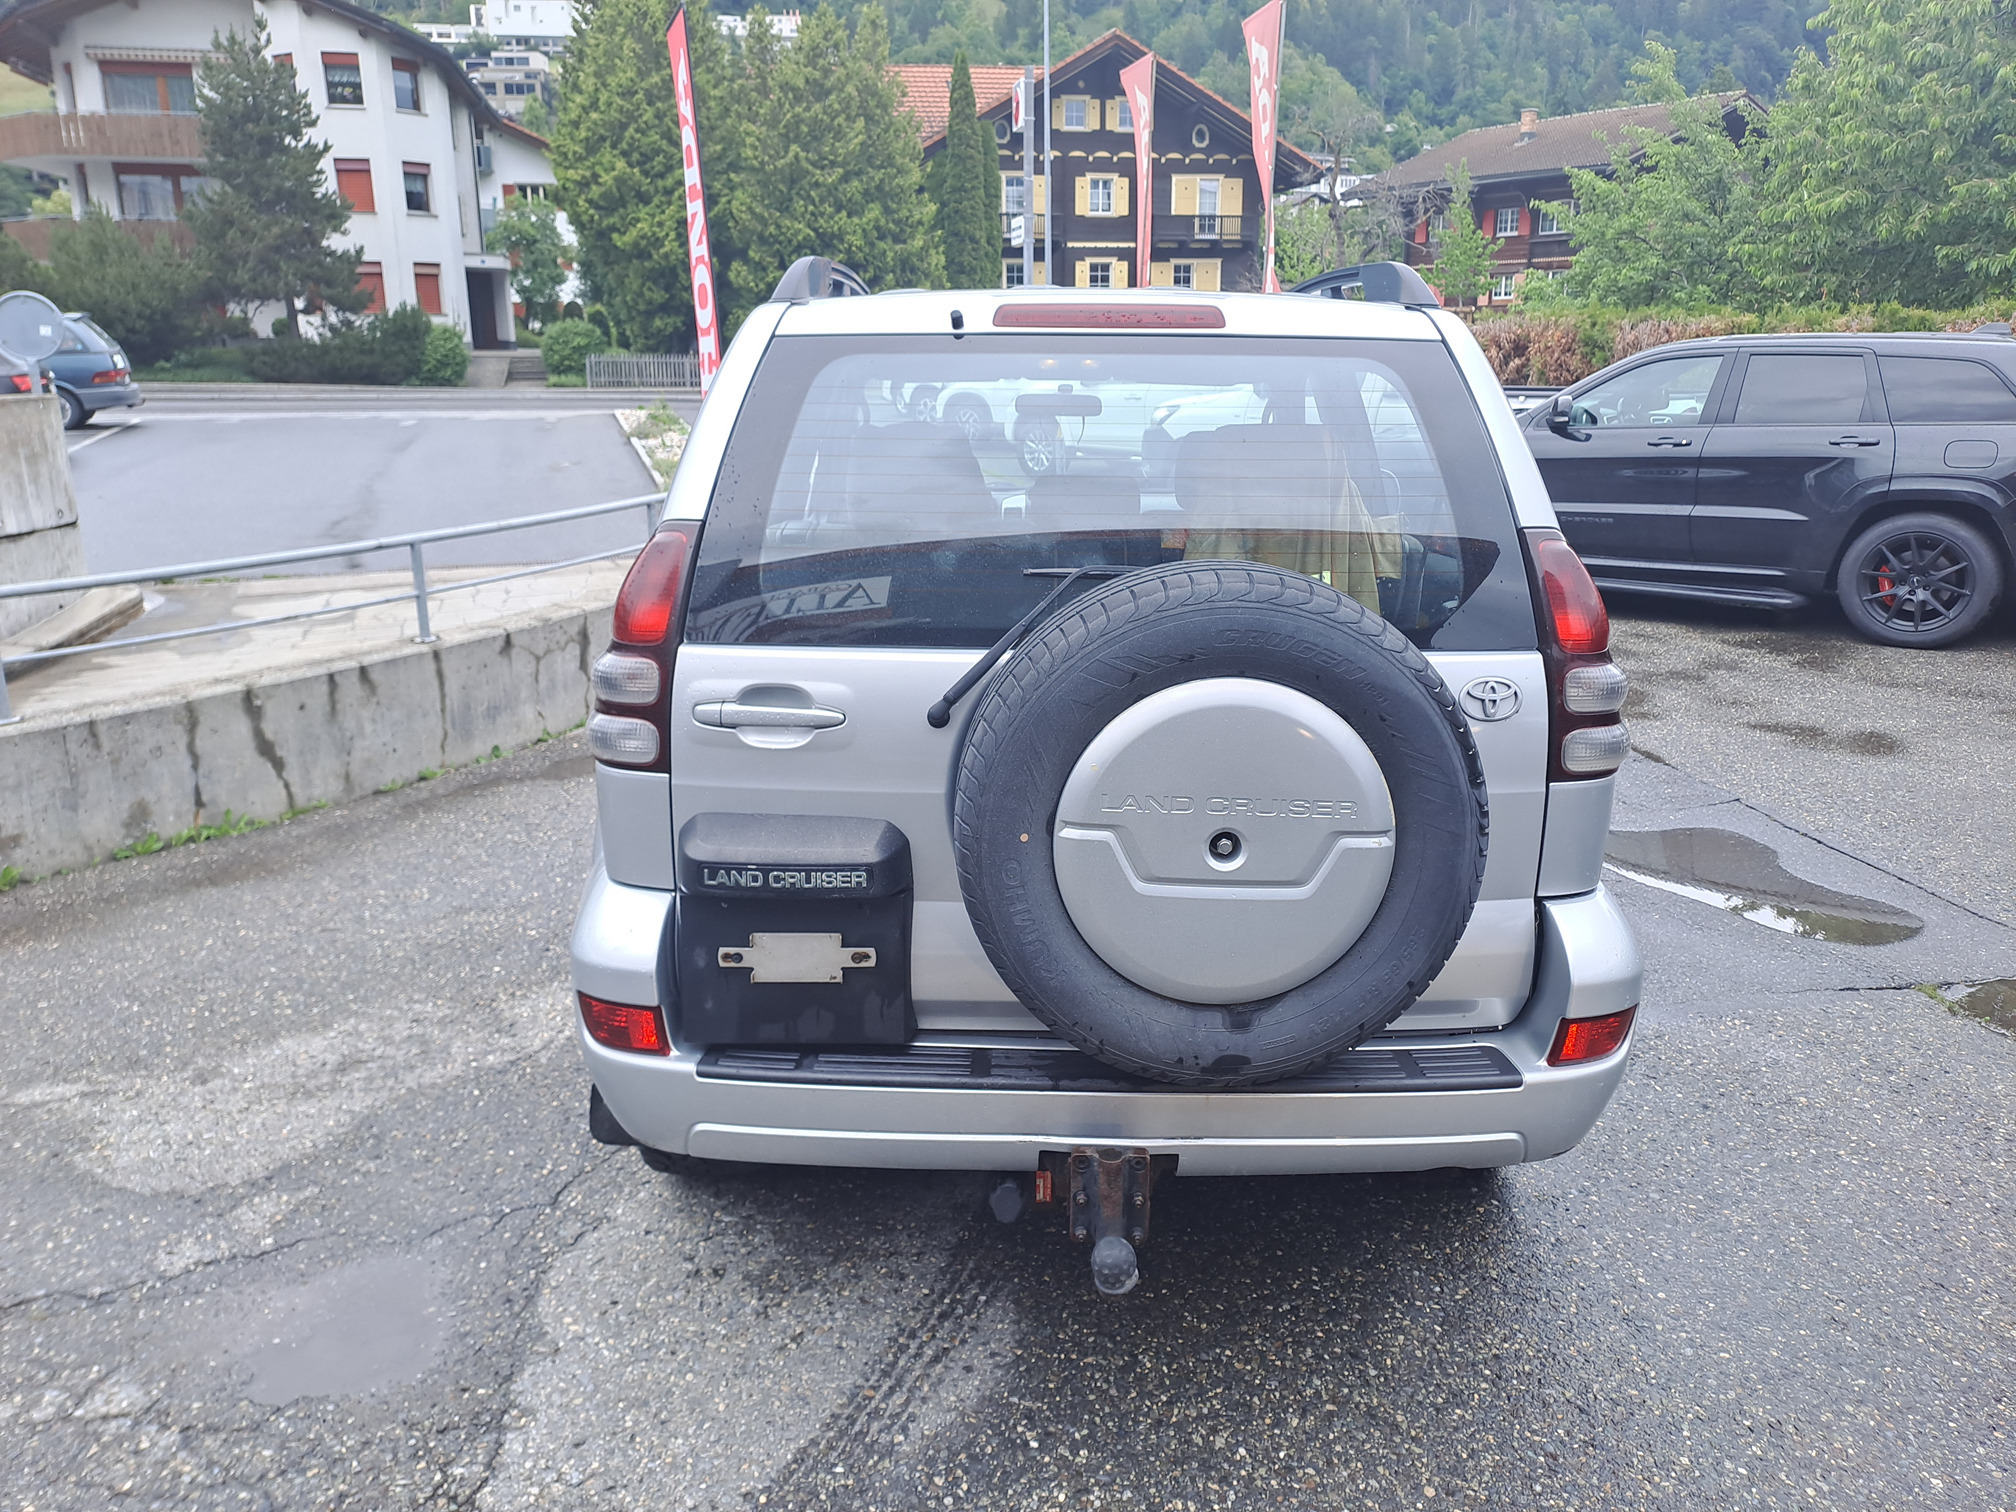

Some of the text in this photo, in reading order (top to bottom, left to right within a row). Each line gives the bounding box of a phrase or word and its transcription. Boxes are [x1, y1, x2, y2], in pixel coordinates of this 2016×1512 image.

[676, 47, 718, 392] HONDA
[1213, 628, 1368, 681] CRUGEN
[1101, 793, 1358, 819] LAND CRUISER
[703, 868, 867, 890] LAND CRUISER
[1000, 857, 1067, 986] KUMHO
